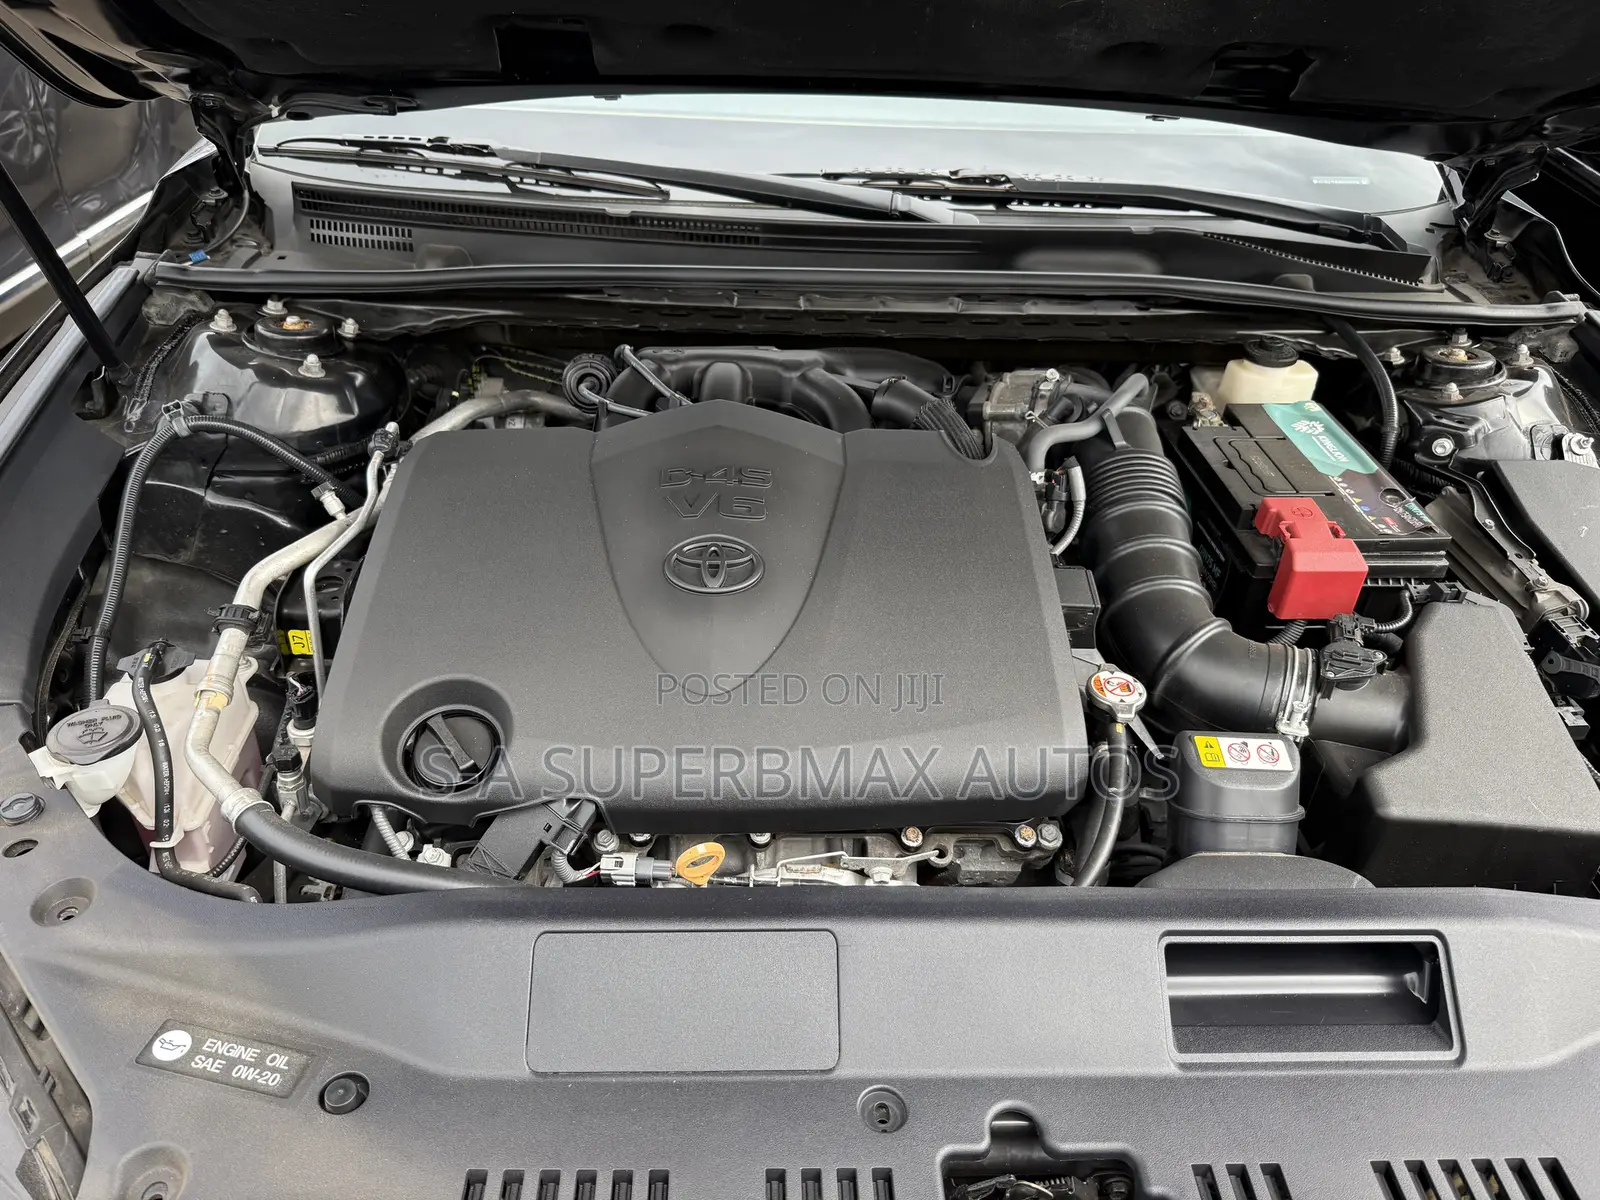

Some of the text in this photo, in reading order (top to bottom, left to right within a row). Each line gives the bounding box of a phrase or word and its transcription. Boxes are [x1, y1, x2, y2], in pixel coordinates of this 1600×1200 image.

[660, 466, 772, 488] D-4S
[663, 492, 767, 521] V6
[291, 635, 306, 649] J7
[202, 1038, 290, 1070] ENGINE OIL
[191, 1055, 281, 1087] SAE 0W-20
